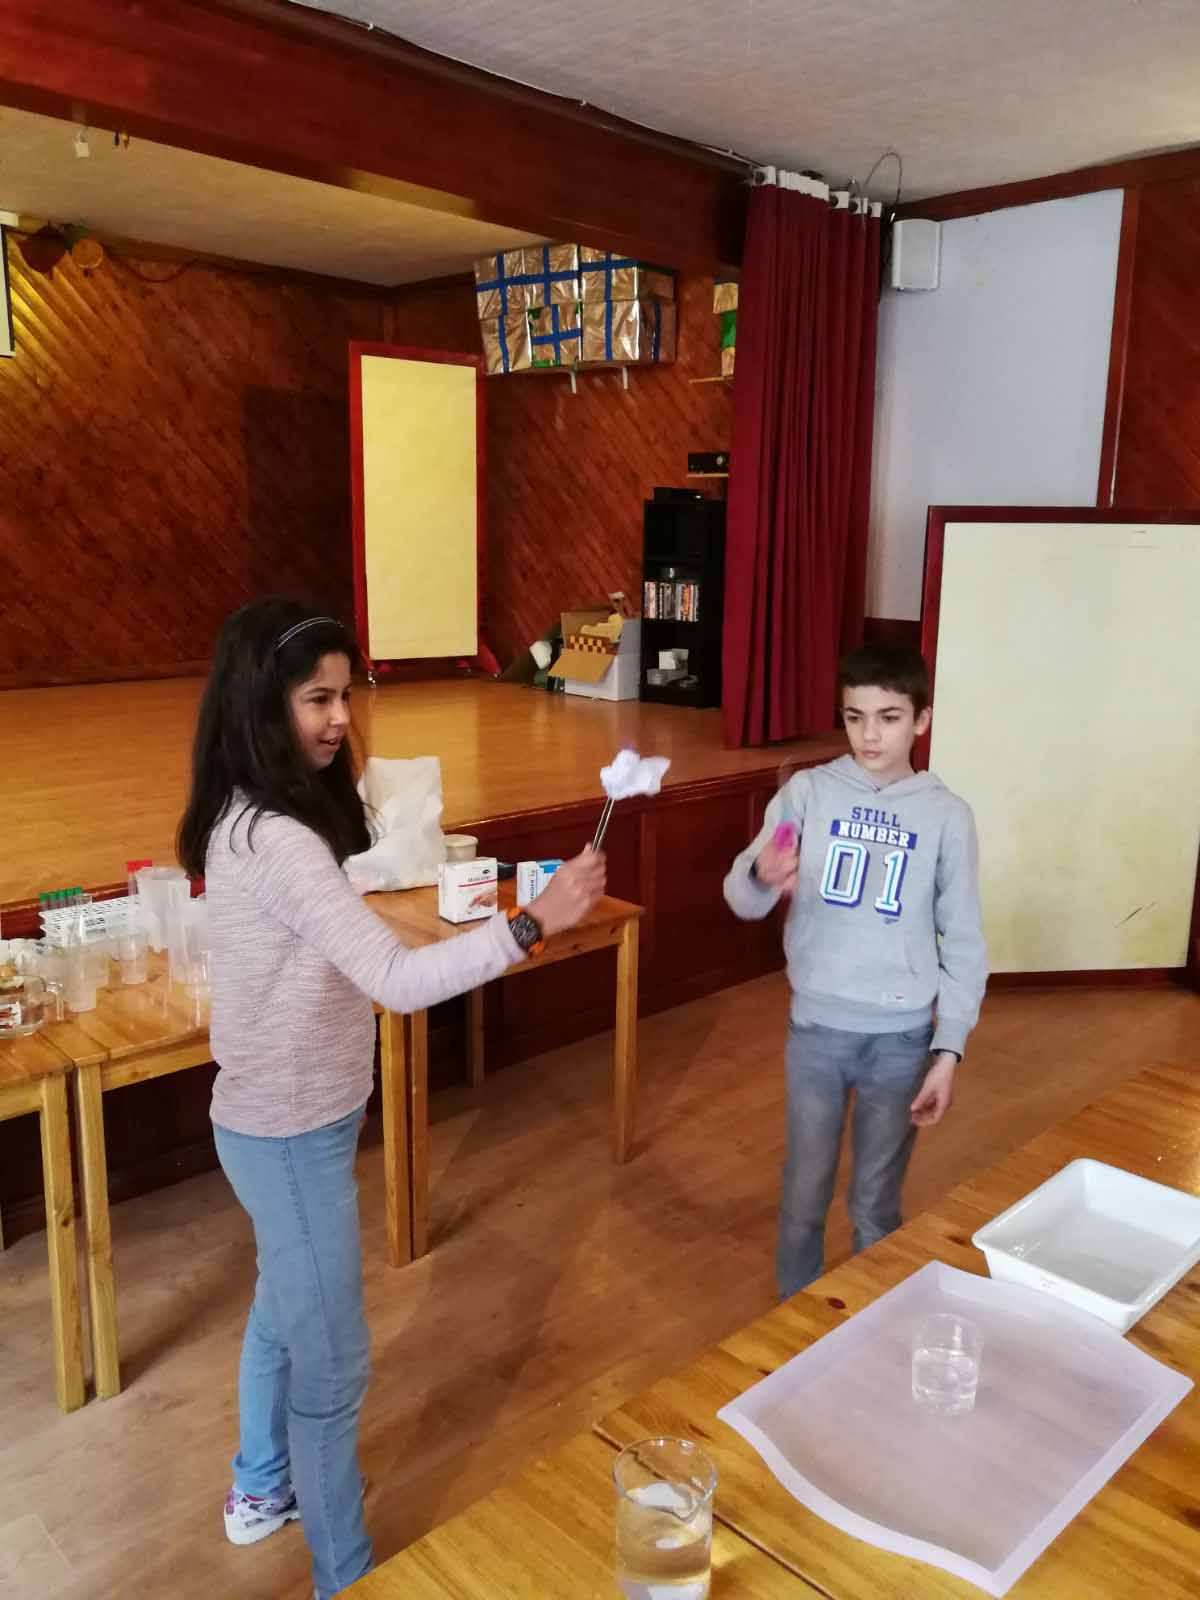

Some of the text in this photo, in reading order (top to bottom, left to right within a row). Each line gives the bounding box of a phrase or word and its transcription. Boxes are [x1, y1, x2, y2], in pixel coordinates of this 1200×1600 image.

[851, 806, 900, 828] STILL
[838, 821, 911, 848] NUMBER
[820, 840, 908, 917] 01
